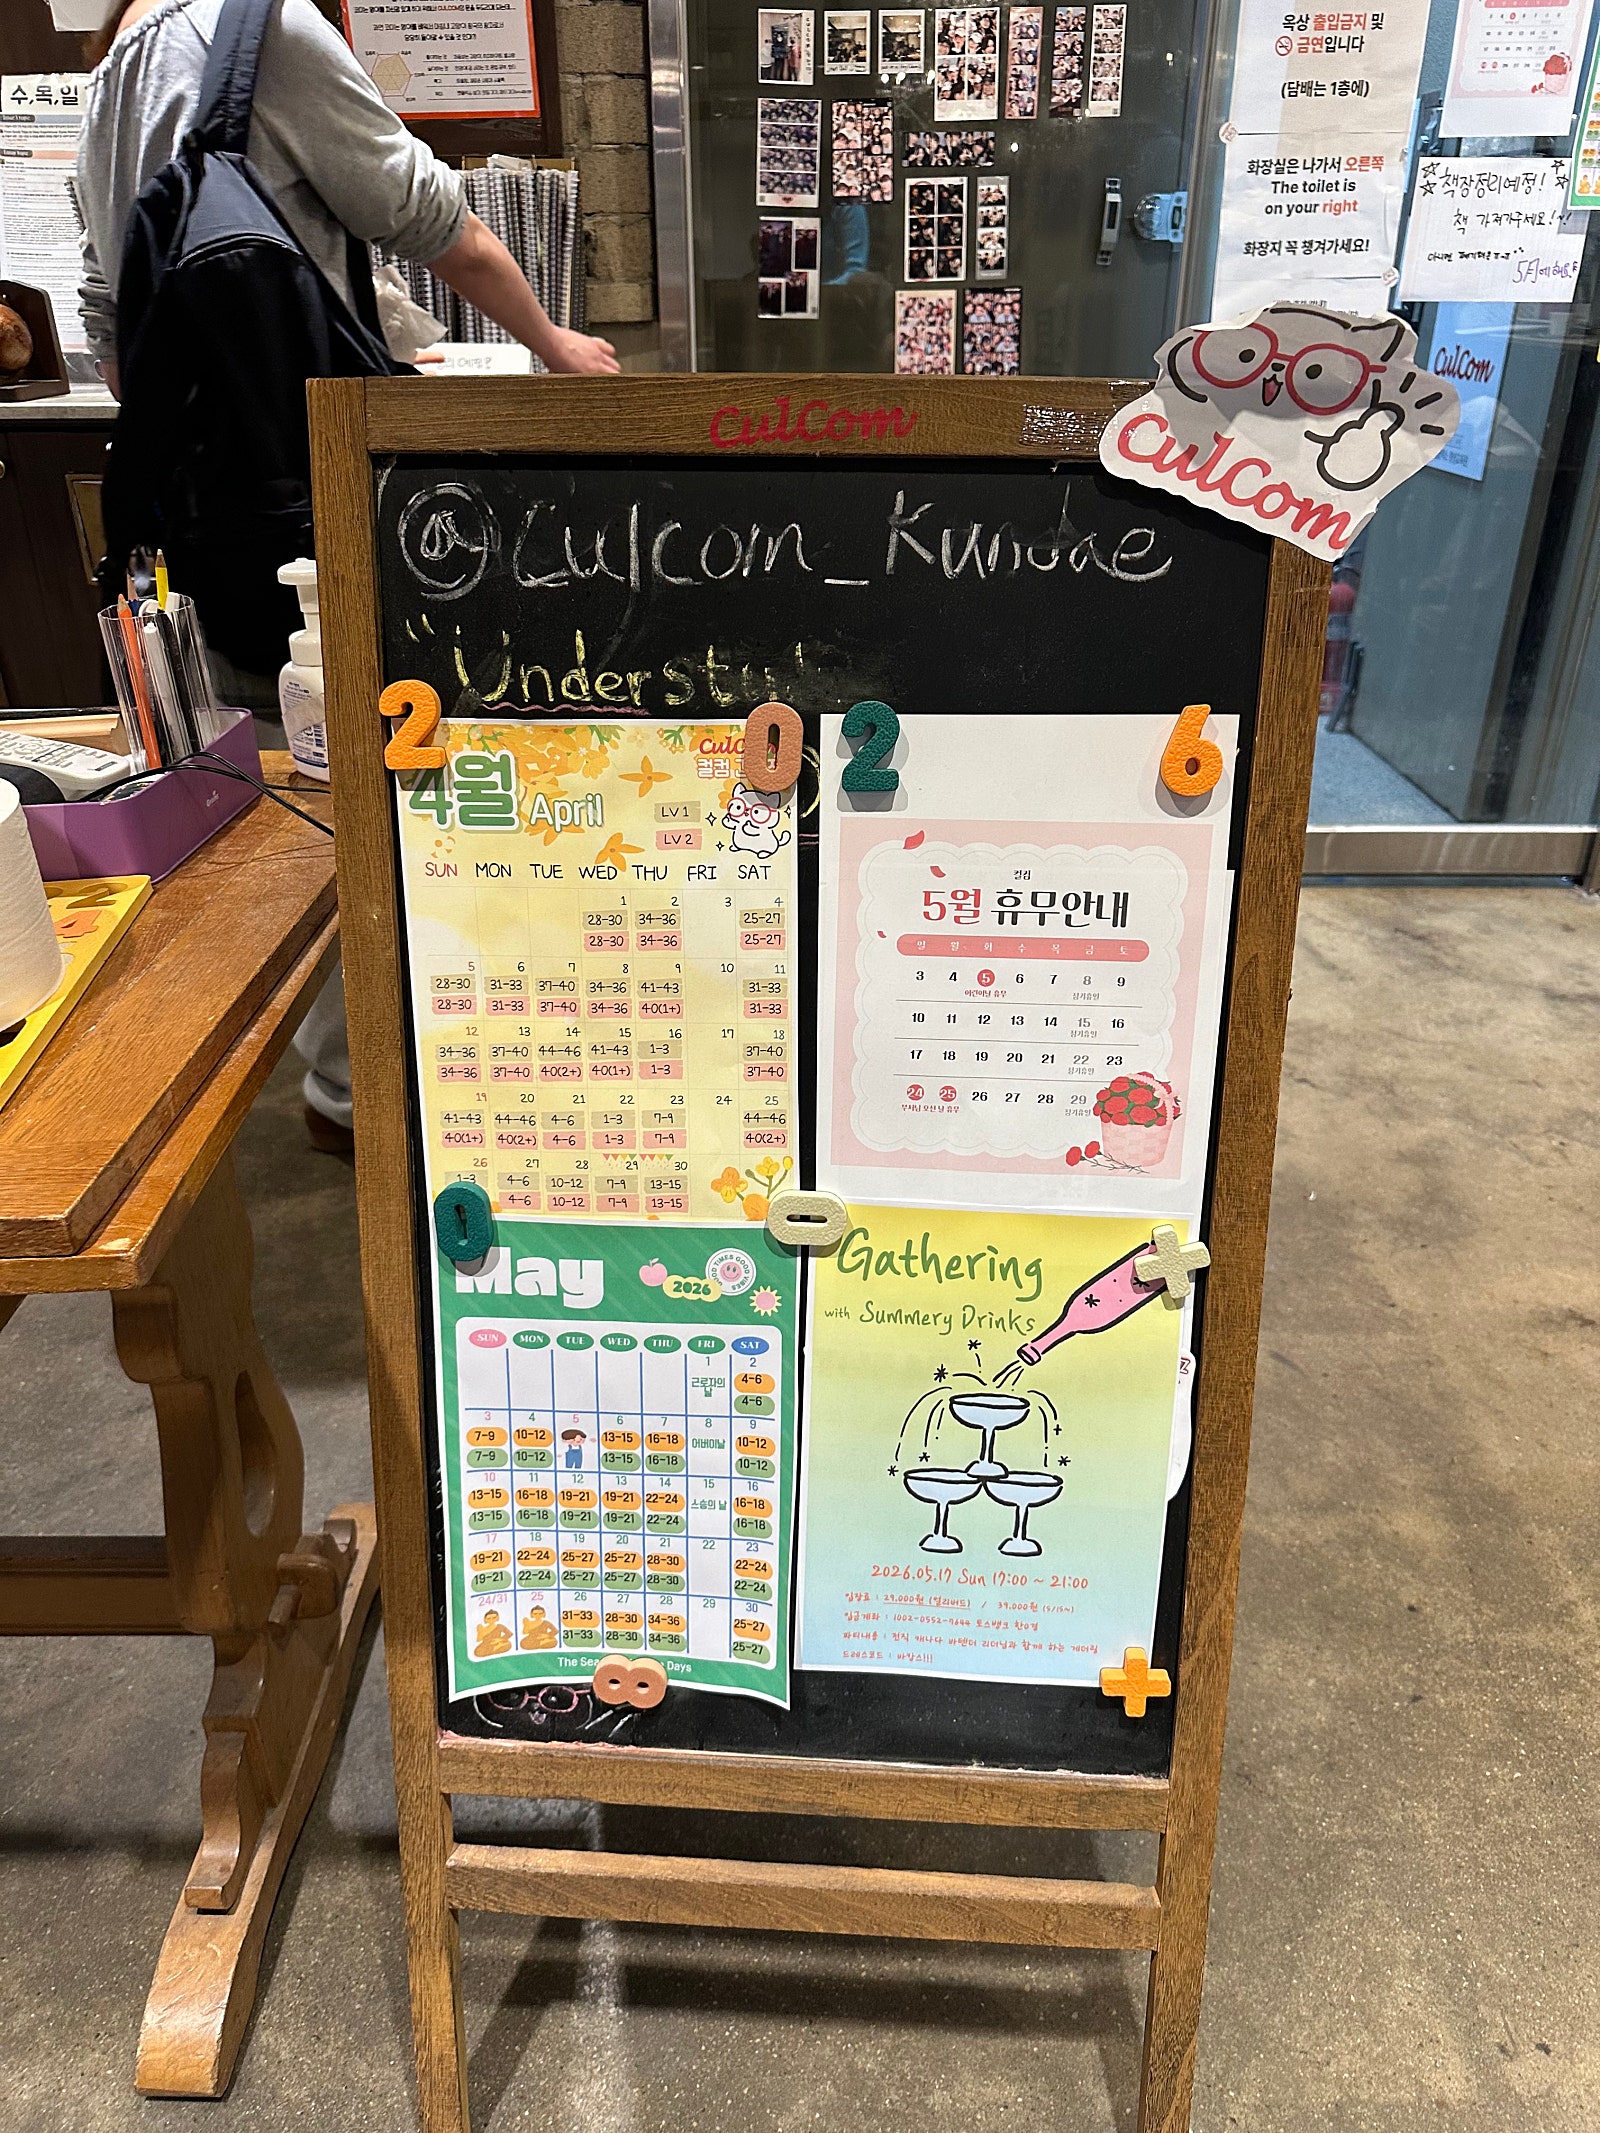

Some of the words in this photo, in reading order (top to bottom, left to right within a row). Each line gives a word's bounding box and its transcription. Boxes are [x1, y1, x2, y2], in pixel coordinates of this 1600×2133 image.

[1282, 14, 1309, 31] 옥상
[1313, 13, 1367, 30] 출입금지
[1371, 12, 1384, 30] 및
[1296, 35, 1364, 54] 금연입니다
[10, 85, 78, 105] 수,목,일
[1280, 80, 1327, 99] (담배는
[1331, 79, 1369, 97] 1층에)
[1247, 158, 1300, 176] 화장실은
[1302, 157, 1341, 174] 나가서
[1344, 155, 1384, 173] 오른쪽
[1271, 180, 1299, 194] The
[1302, 179, 1340, 193] toilet
[1343, 178, 1356, 192] is
[1439, 167, 1547, 198] 책장정리예정!
[1265, 202, 1283, 216] on
[1286, 202, 1319, 217] your
[1322, 199, 1358, 216] right
[1454, 208, 1468, 235] 책
[1243, 240, 1281, 257] 화장지
[1284, 240, 1299, 256] 꼭
[1302, 239, 1369, 256] 챙겨가세요!
[1434, 344, 1495, 383] CulCom
[708, 397, 918, 449] CulCom
[1117, 413, 1353, 550] CulCom
[378, 679, 447, 771] 2
[842, 700, 900, 792] 2
[1160, 703, 1223, 796] 6
[409, 753, 518, 829] 4월
[530, 793, 604, 827] April
[660, 806, 680, 819] LV
[683, 806, 690, 818] 1
[664, 833, 683, 846] LV
[685, 833, 694, 845] 2
[425, 862, 458, 877] SUN
[475, 863, 512, 878] MON
[529, 863, 564, 879] TUE
[578, 864, 618, 881] WED
[632, 864, 668, 881] THU
[687, 865, 717, 881] FRI
[738, 864, 771, 881] SAT
[620, 896, 627, 906] 1
[671, 896, 679, 907] 2
[724, 896, 732, 908] 3
[774, 896, 783, 907] 4
[922, 888, 981, 925] 5월
[991, 888, 1129, 928] 휴무안내
[587, 913, 623, 926] 28-30
[635, 912, 677, 926] 34-36
[743, 911, 780, 925] 25-27
[589, 934, 624, 948] 28-30
[640, 933, 677, 947] 34-36
[744, 933, 781, 947] 25-27
[917, 940, 926, 950] 일
[950, 941, 959, 951] 월
[984, 942, 993, 952] 화
[1018, 943, 1027, 953] 수
[1084, 945, 1094, 955] 금
[1120, 946, 1128, 955] 토
[468, 961, 475, 972] 5
[518, 962, 525, 973] 6
[568, 962, 576, 973] 7
[622, 963, 629, 974] 8
[675, 963, 681, 974] 9
[721, 963, 734, 974] 10
[774, 964, 786, 974] 11
[435, 977, 471, 991] 28-30
[490, 979, 523, 992] 31-33
[538, 979, 576, 993] 37-40
[589, 981, 627, 994] 34-36
[640, 981, 680, 994] 41-43
[748, 980, 782, 994] 31-33
[916, 970, 924, 981] 3
[949, 972, 957, 982] 4
[1016, 974, 1024, 984] 6
[1050, 974, 1058, 984] 7
[1083, 976, 1092, 985] 8
[1117, 977, 1125, 987] 9
[437, 998, 472, 1012] 28-30
[491, 999, 524, 1012] 31-33
[540, 1000, 577, 1013] 37-40
[590, 1001, 628, 1015] 34-36
[641, 1002, 681, 1016] 40(1+)
[749, 1002, 782, 1015] 31-33
[837, 1227, 1044, 1301] Gathering
[455, 1247, 604, 1309] May
[673, 1280, 712, 1295] 2026
[824, 1306, 850, 1320] with
[859, 1301, 954, 1336] Summery
[961, 1304, 1036, 1336] Drinks
[477, 1333, 499, 1343] SUN
[520, 1334, 544, 1344] MON
[565, 1336, 585, 1346] TUE
[607, 1336, 631, 1346] WED
[651, 1338, 674, 1348] THU
[697, 1339, 715, 1349] FRI
[739, 1340, 761, 1350] SAT
[705, 1356, 710, 1366] 1
[749, 1357, 757, 1368] 2
[741, 1374, 762, 1385] 4-6
[484, 1411, 491, 1421] 3
[528, 1413, 535, 1422] 4
[572, 1414, 579, 1423] 5
[616, 1416, 624, 1425] 6
[661, 1417, 668, 1426] 7
[705, 1418, 712, 1428] 8
[749, 1419, 757, 1429] 9
[475, 1430, 495, 1441] 7-9
[515, 1429, 546, 1440] 10-12
[604, 1432, 633, 1443] 13-15
[648, 1433, 679, 1445] 16-18
[737, 1437, 767, 1449] 10-12
[871, 1564, 952, 1585] 2026.05.17
[957, 1568, 987, 1587] Sun
[992, 1571, 1028, 1589] 17:00
[1050, 1574, 1089, 1590] 21:00
[557, 1657, 578, 1668] The
[667, 1661, 692, 1673] Days
